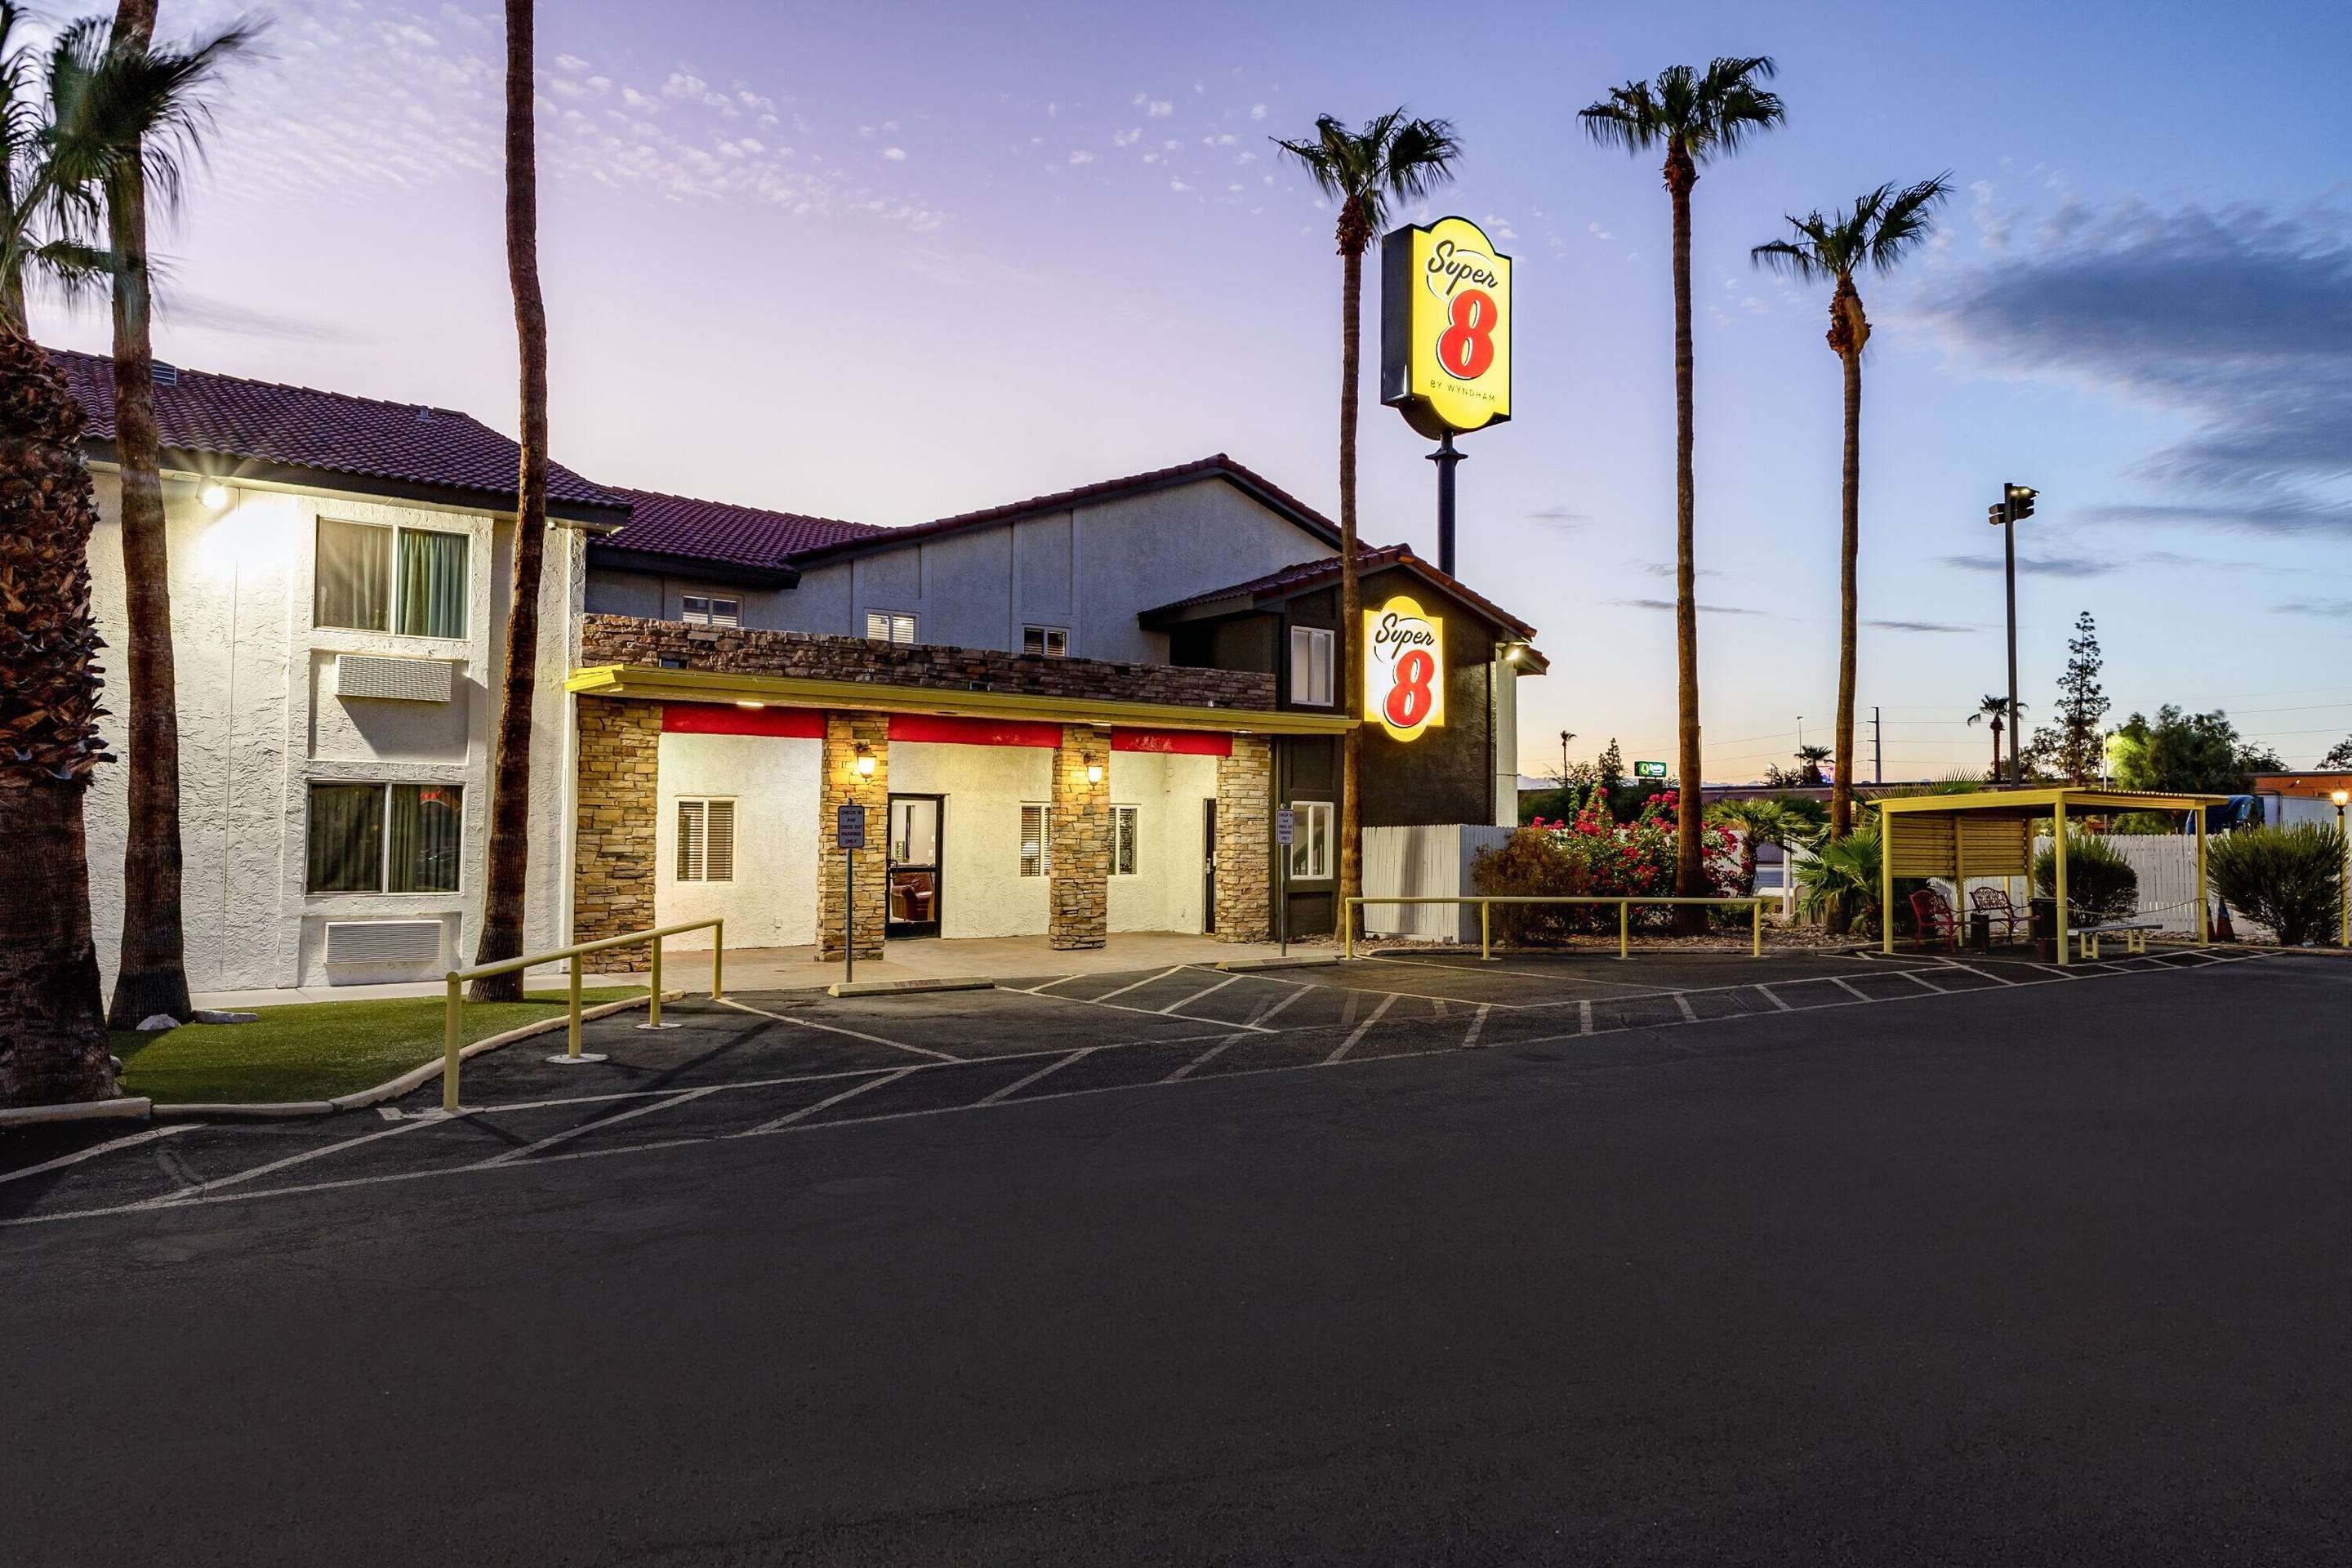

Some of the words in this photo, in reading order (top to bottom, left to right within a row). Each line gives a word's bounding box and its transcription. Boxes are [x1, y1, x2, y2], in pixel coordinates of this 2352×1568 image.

[1428, 239, 1499, 295] Super
[1437, 289, 1498, 381] 8
[1430, 380, 1442, 388] BY
[1448, 384, 1495, 403] WYNDHAM
[1375, 612, 1435, 660] Super
[1383, 649, 1435, 728] 8
